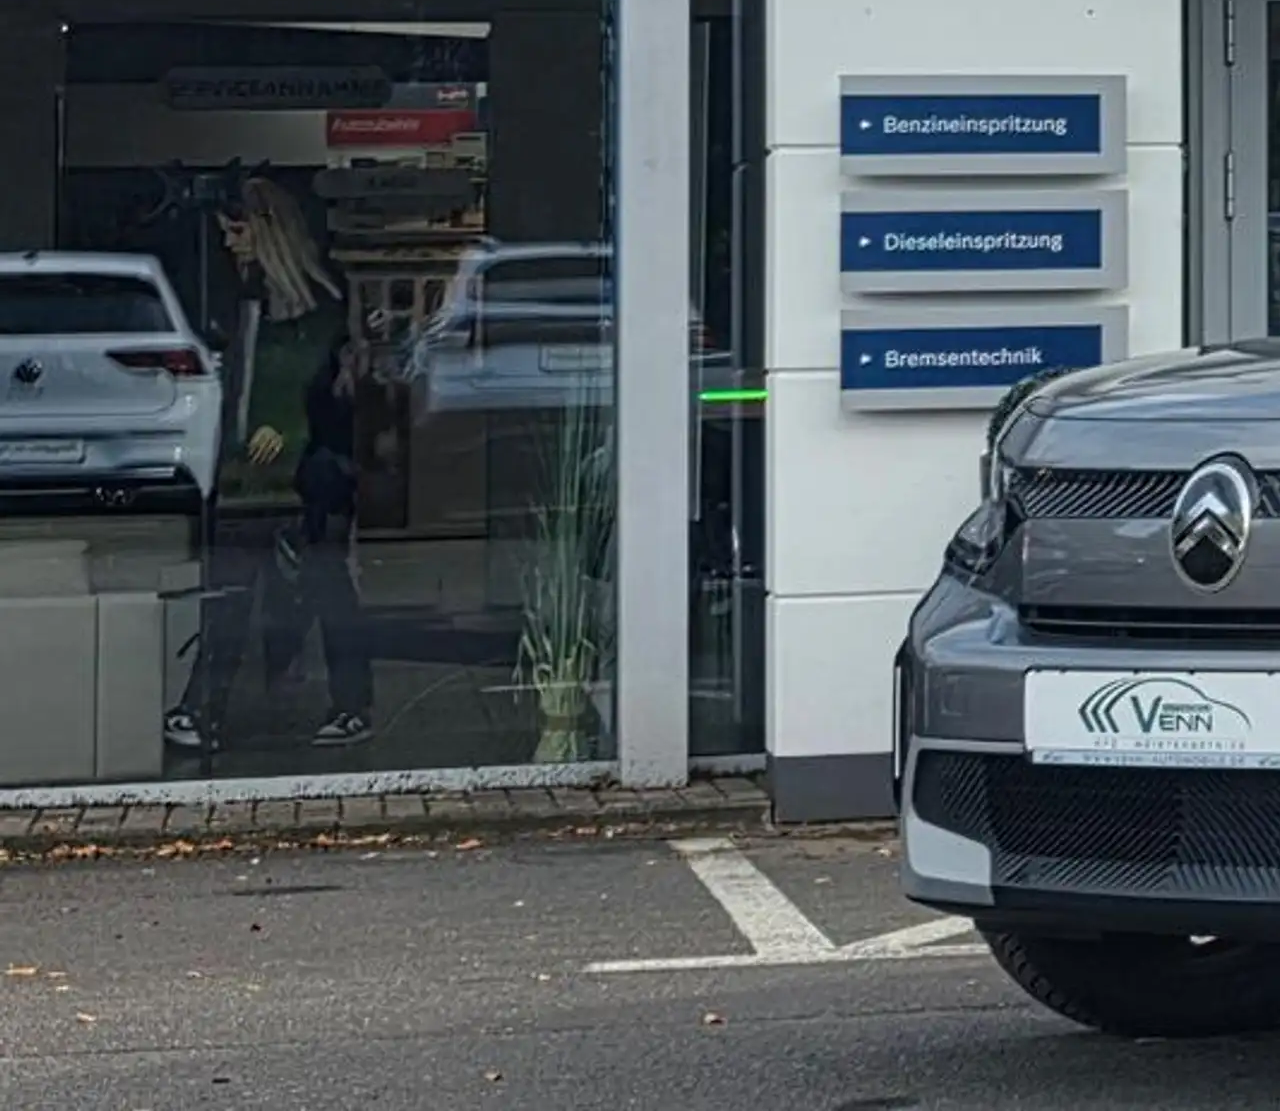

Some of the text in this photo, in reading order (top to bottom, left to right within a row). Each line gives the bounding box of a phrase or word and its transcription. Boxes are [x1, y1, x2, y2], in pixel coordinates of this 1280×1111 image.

[883, 115, 1068, 135] Benzineinspritzung
[884, 231, 1063, 253] Dieseleinspritzung
[885, 346, 1043, 368] Bremsentechnik
[1130, 695, 1213, 733] VENN
